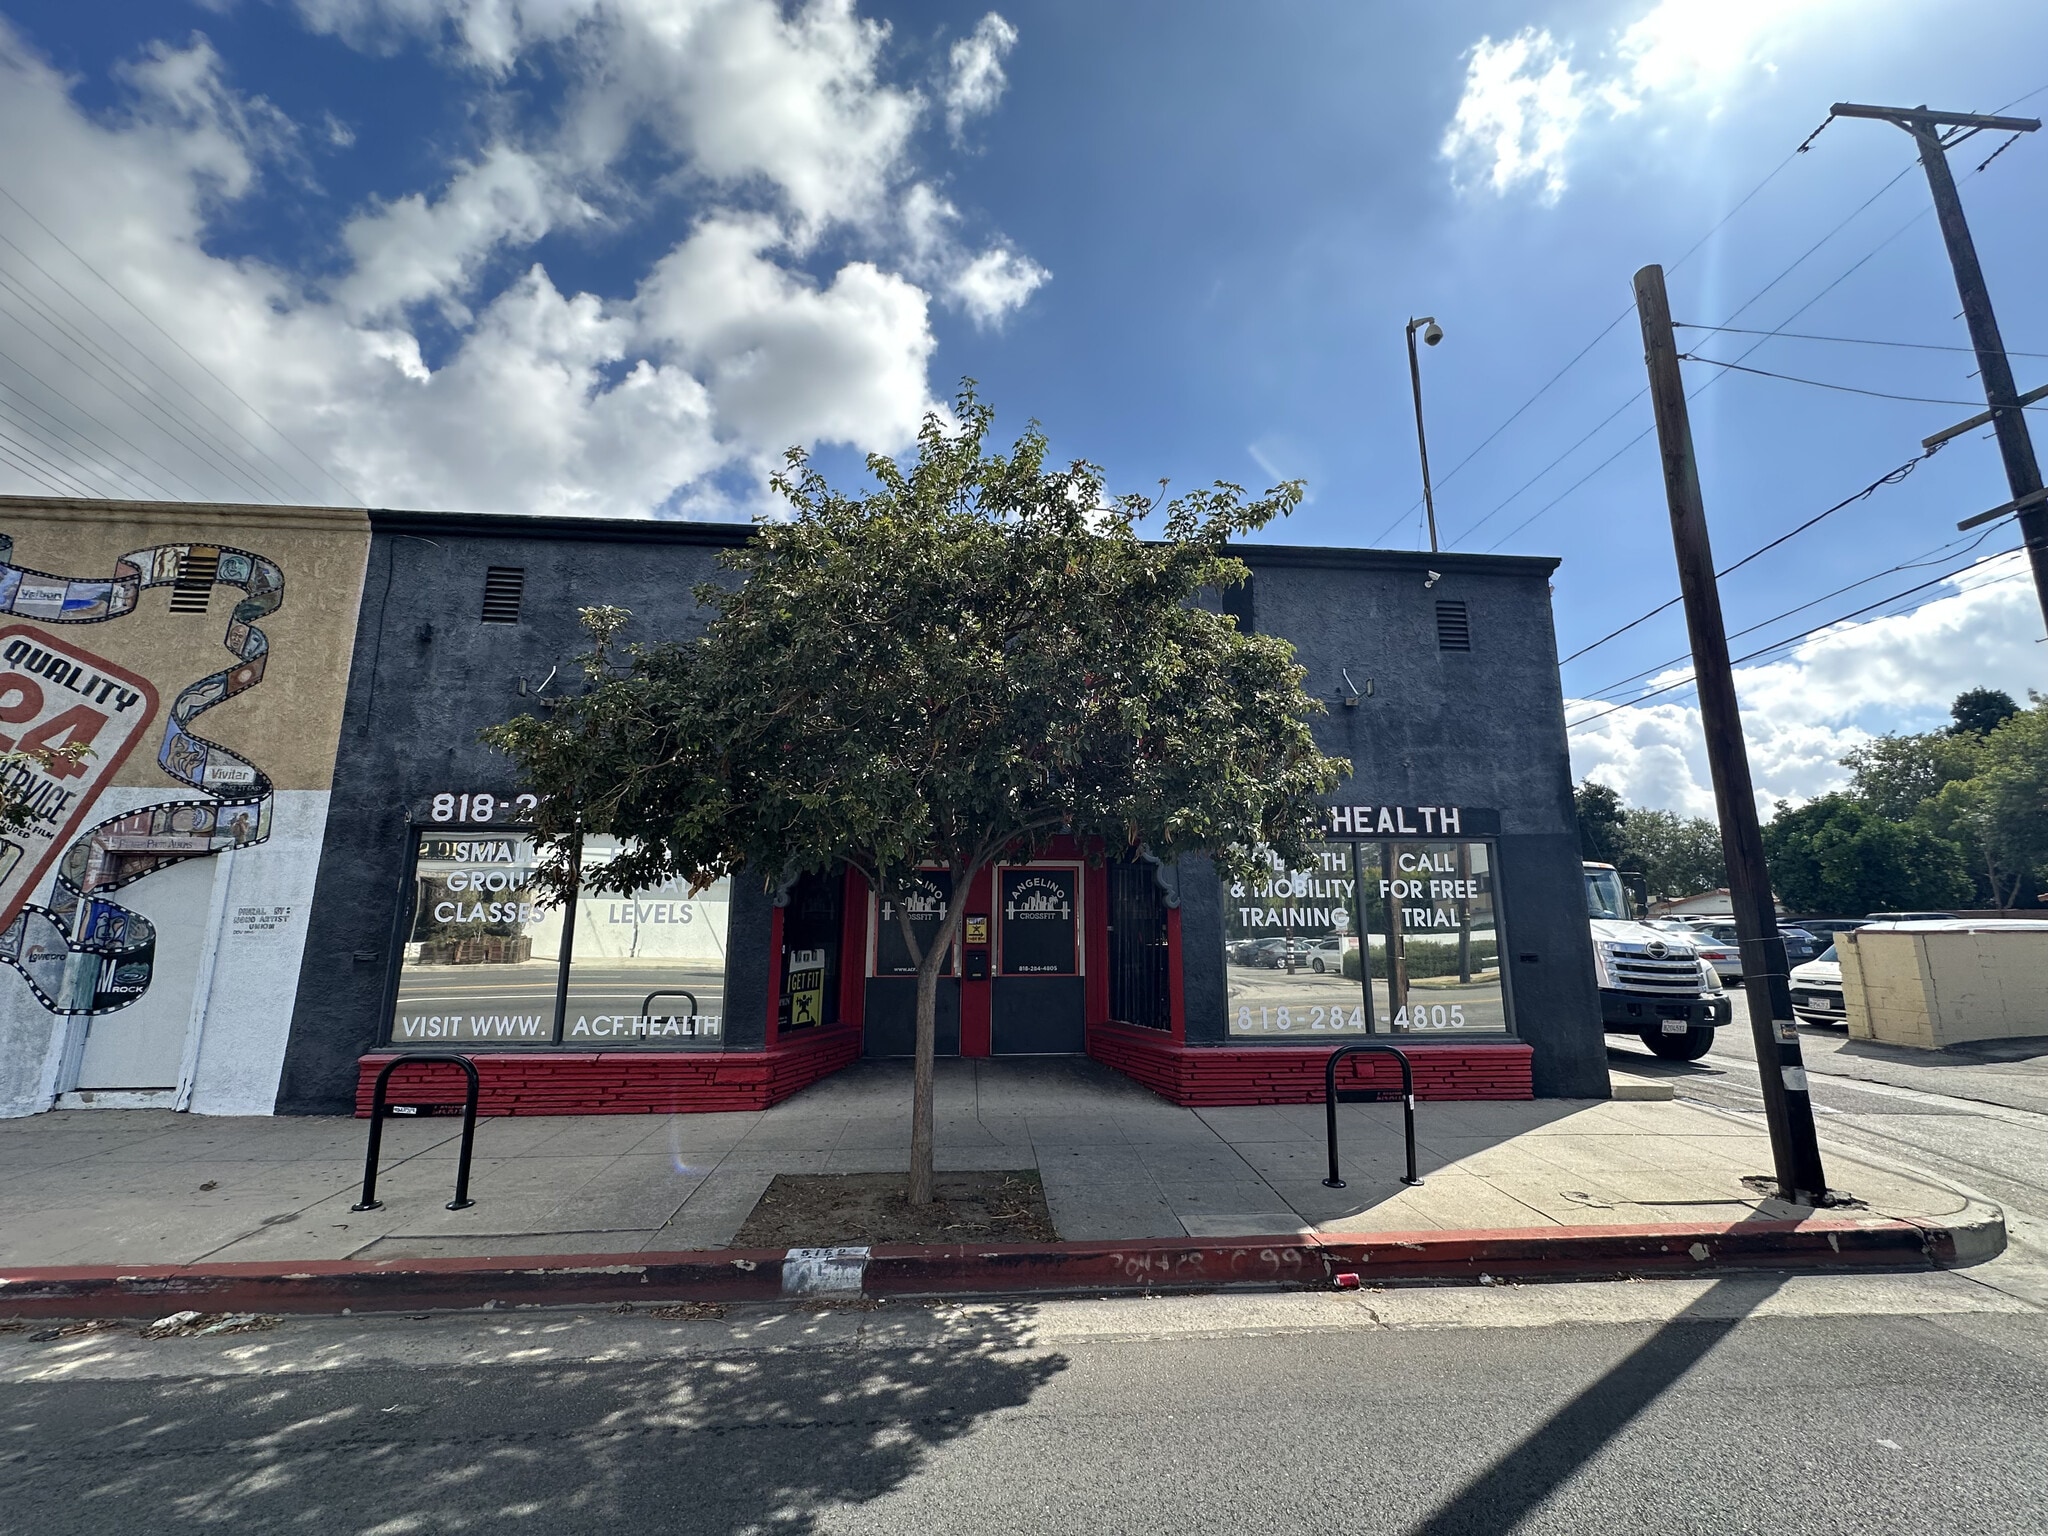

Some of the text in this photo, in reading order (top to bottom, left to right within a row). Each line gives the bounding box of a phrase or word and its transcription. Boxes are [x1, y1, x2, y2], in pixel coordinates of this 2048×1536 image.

[3, 640, 140, 712] QUALITY
[211, 769, 249, 780] Vivitar
[32, 826, 54, 840] FILM
[1399, 853, 1454, 872] CALL
[447, 871, 534, 892] GROU
[1012, 878, 1065, 899] ANGELINO
[1230, 879, 1355, 898] & MOBILITY
[1379, 880, 1478, 899] FOR FREE
[238, 907, 266, 916] MURAL
[434, 902, 545, 923] CLASSES
[609, 904, 693, 924] LEVELS
[1239, 907, 1350, 927] TRAINING
[1402, 908, 1461, 927] TRIAL
[791, 971, 820, 991] GET FIT
[402, 1015, 719, 1037] VISIT WWW. ACF.HEALTH
